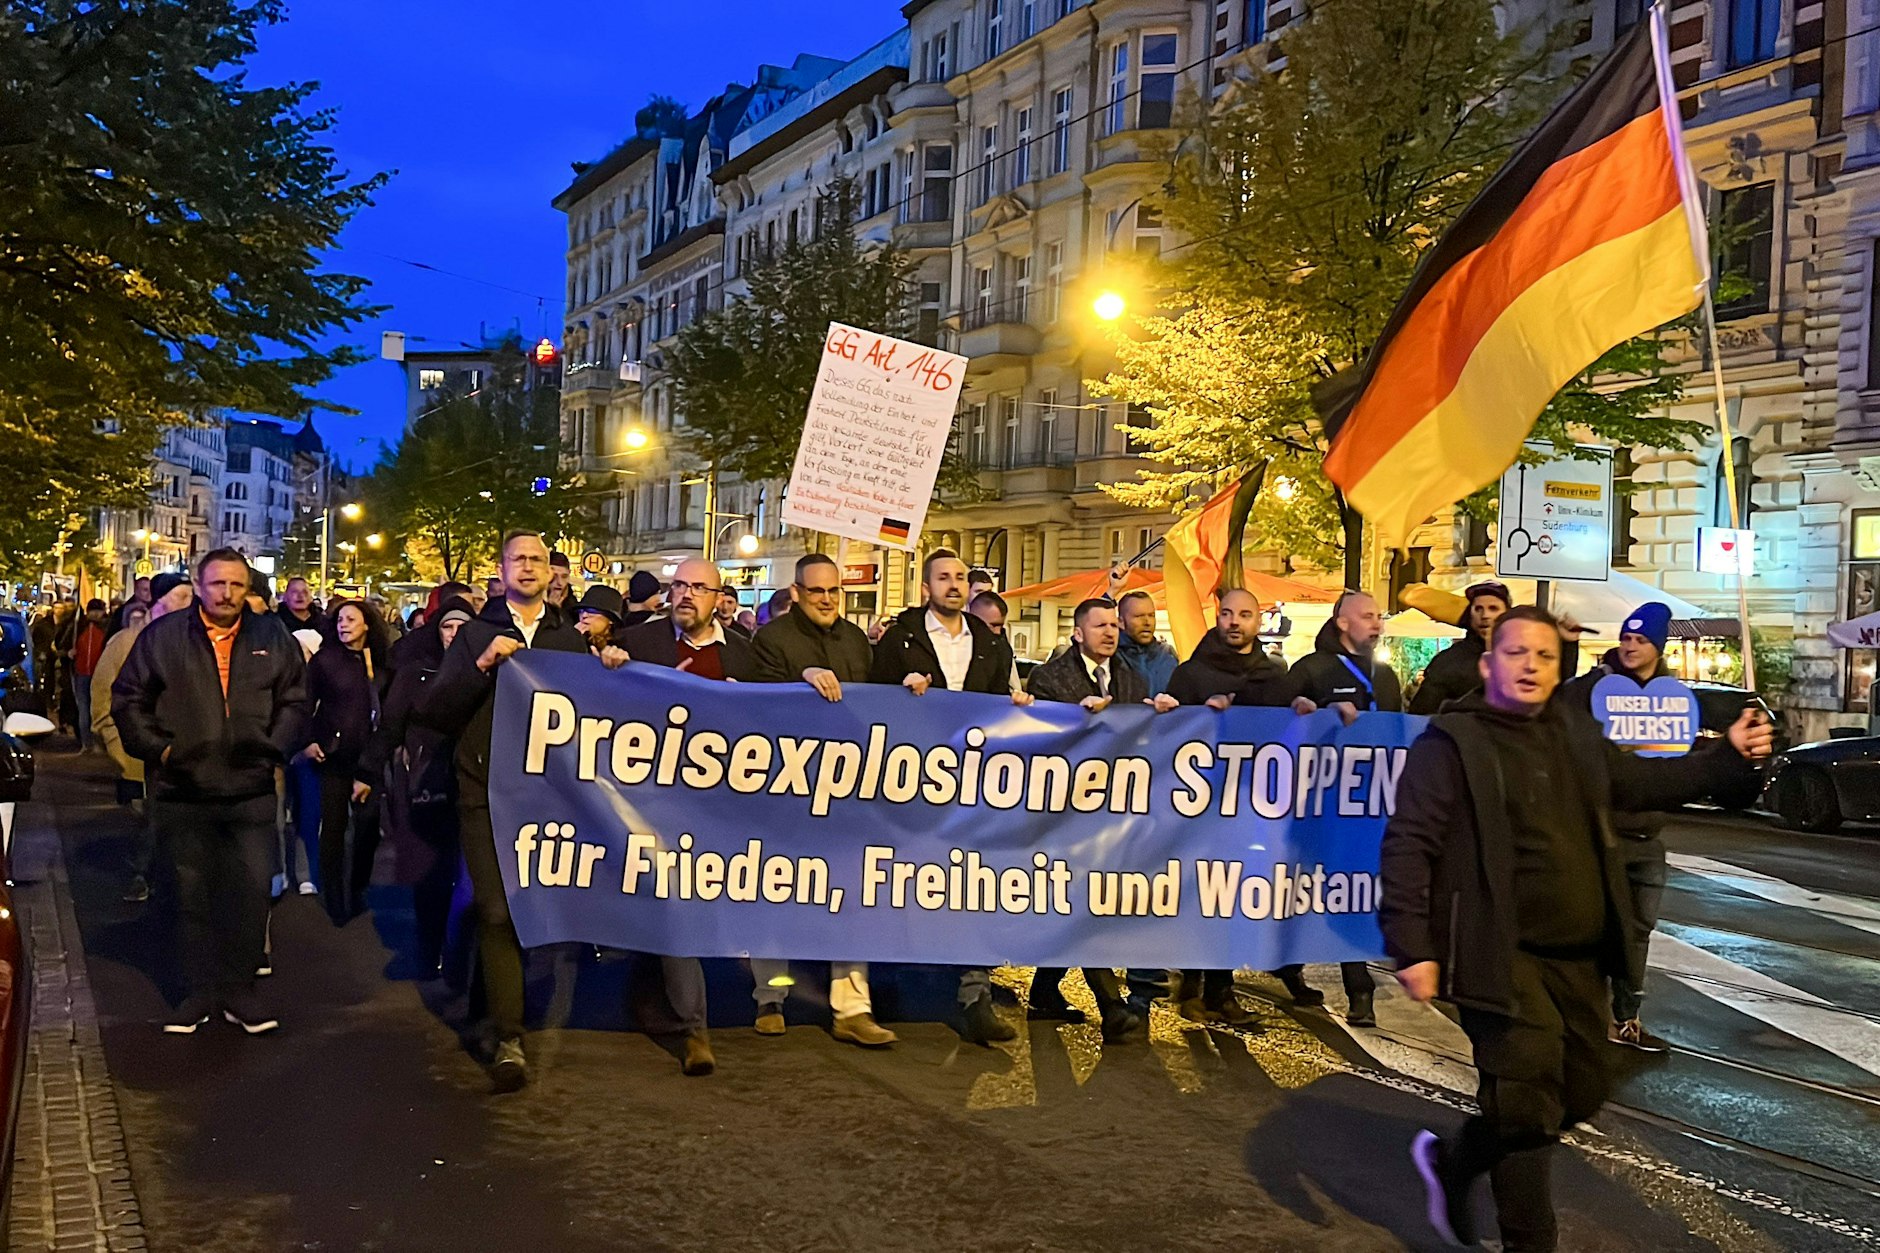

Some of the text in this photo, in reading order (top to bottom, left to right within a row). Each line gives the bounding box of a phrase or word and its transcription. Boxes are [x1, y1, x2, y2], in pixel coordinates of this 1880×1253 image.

[827, 328, 860, 361] GG
[906, 351, 954, 391] 146
[1546, 484, 1599, 497] Fernverkehr
[1542, 520, 1588, 534] Sudenburg
[590, 556, 598, 569] H
[1606, 696, 1690, 714] UNSER LAND
[1608, 716, 1690, 740] ZUERST!
[525, 691, 1407, 818] Preisexplosionen STOPPEN
[514, 821, 1383, 920] für Frieden, Freiheit und Wohlstan
